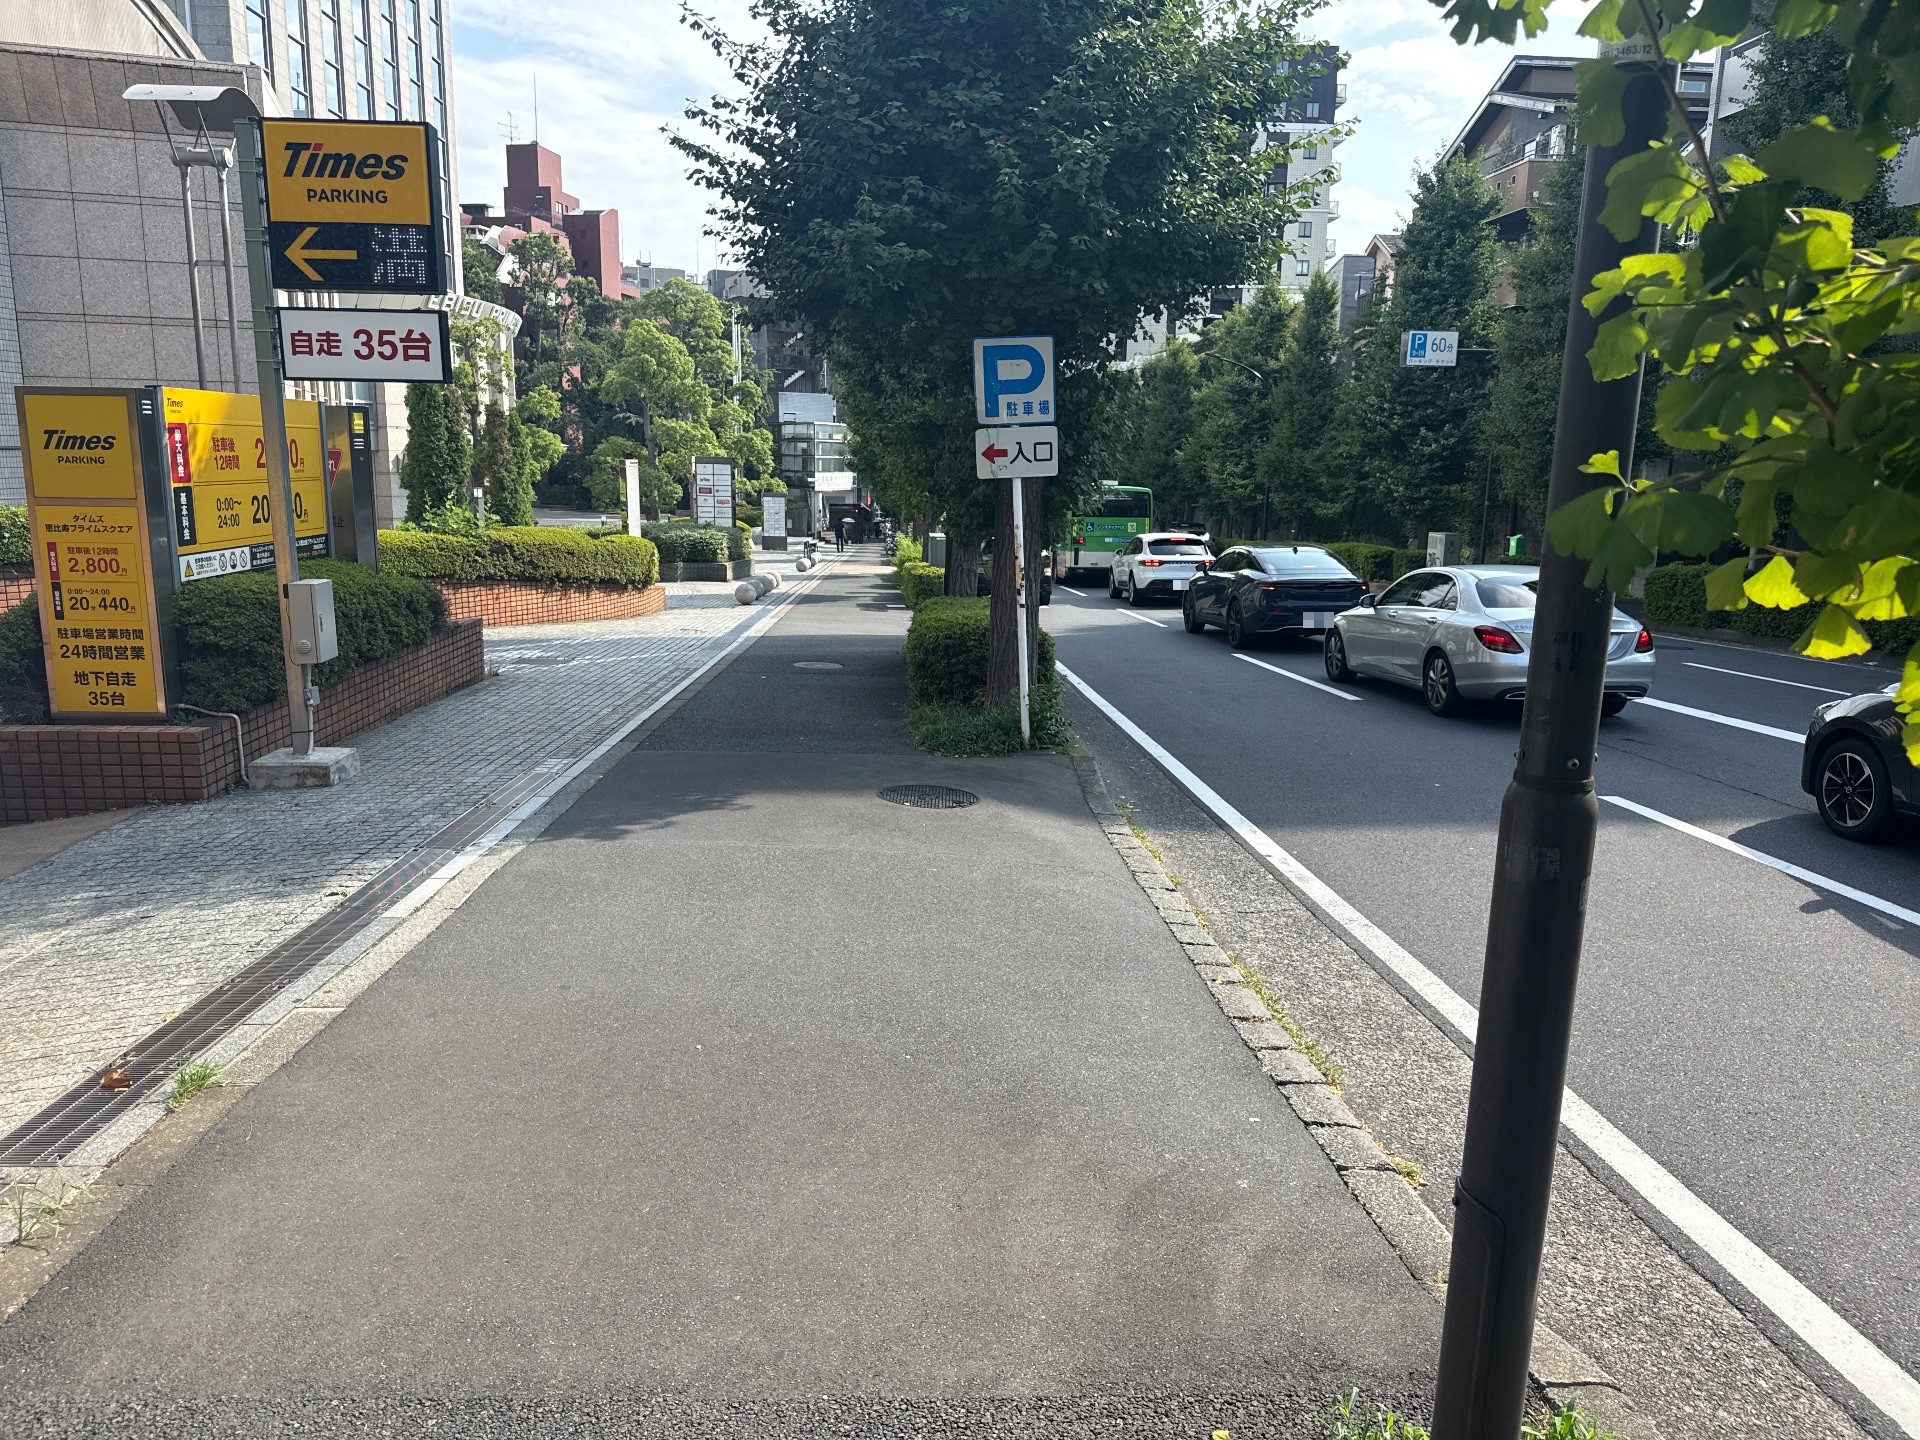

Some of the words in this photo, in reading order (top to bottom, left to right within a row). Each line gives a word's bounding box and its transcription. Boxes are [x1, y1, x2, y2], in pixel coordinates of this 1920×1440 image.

[283, 142, 409, 180] Times
[306, 188, 389, 204] PARKING
[372, 227, 427, 284] 満
[290, 330, 343, 357] 自走
[353, 328, 433, 362] 35台
[1415, 334, 1425, 349] P
[1431, 337, 1454, 353] 60分
[982, 344, 1046, 418] P
[166, 397, 184, 408] Times
[1006, 400, 1050, 417] 駐車場
[41, 428, 117, 451] Times
[211, 436, 236, 453] 駐車後
[57, 455, 106, 465] PARKING
[173, 428, 185, 478] 最大料金
[1009, 441, 1053, 464] 入口
[213, 454, 241, 470] 12時間
[72, 514, 104, 523] タイムズ
[180, 492, 191, 540] 基本料金
[217, 513, 240, 528] 24:00
[67, 546, 119, 556] 駐車後12時間
[57, 627, 144, 641] 駐車場営業時間
[59, 644, 146, 660] 24時間営業
[73, 671, 137, 686] 地下自走
[88, 691, 126, 707] 35台
